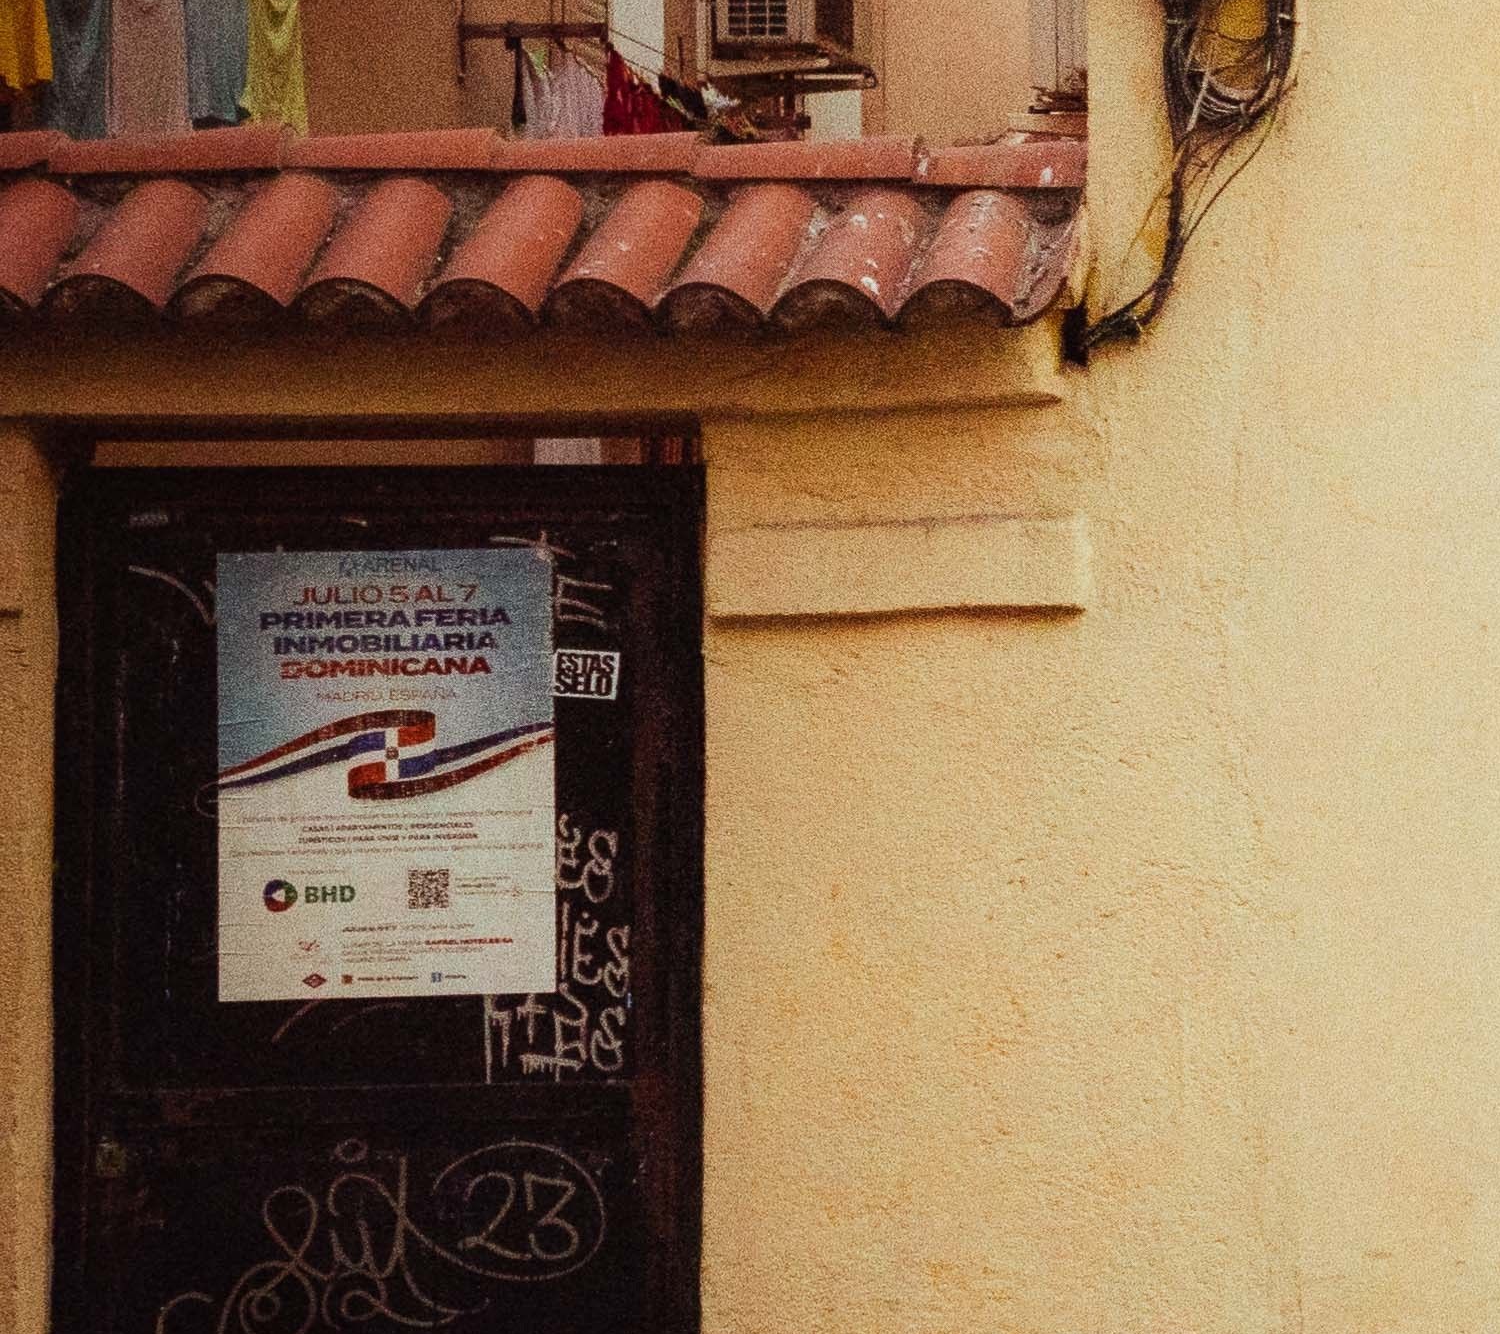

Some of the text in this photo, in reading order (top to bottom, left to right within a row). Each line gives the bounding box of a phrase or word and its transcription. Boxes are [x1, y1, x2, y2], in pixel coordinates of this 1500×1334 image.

[293, 583, 478, 606] JULIO 5 AL 7
[259, 607, 513, 631] PRIMERA FERIA
[273, 630, 498, 655] INMOBILIARIA
[279, 656, 492, 680] DOMINICANA
[304, 884, 356, 904] BHD
